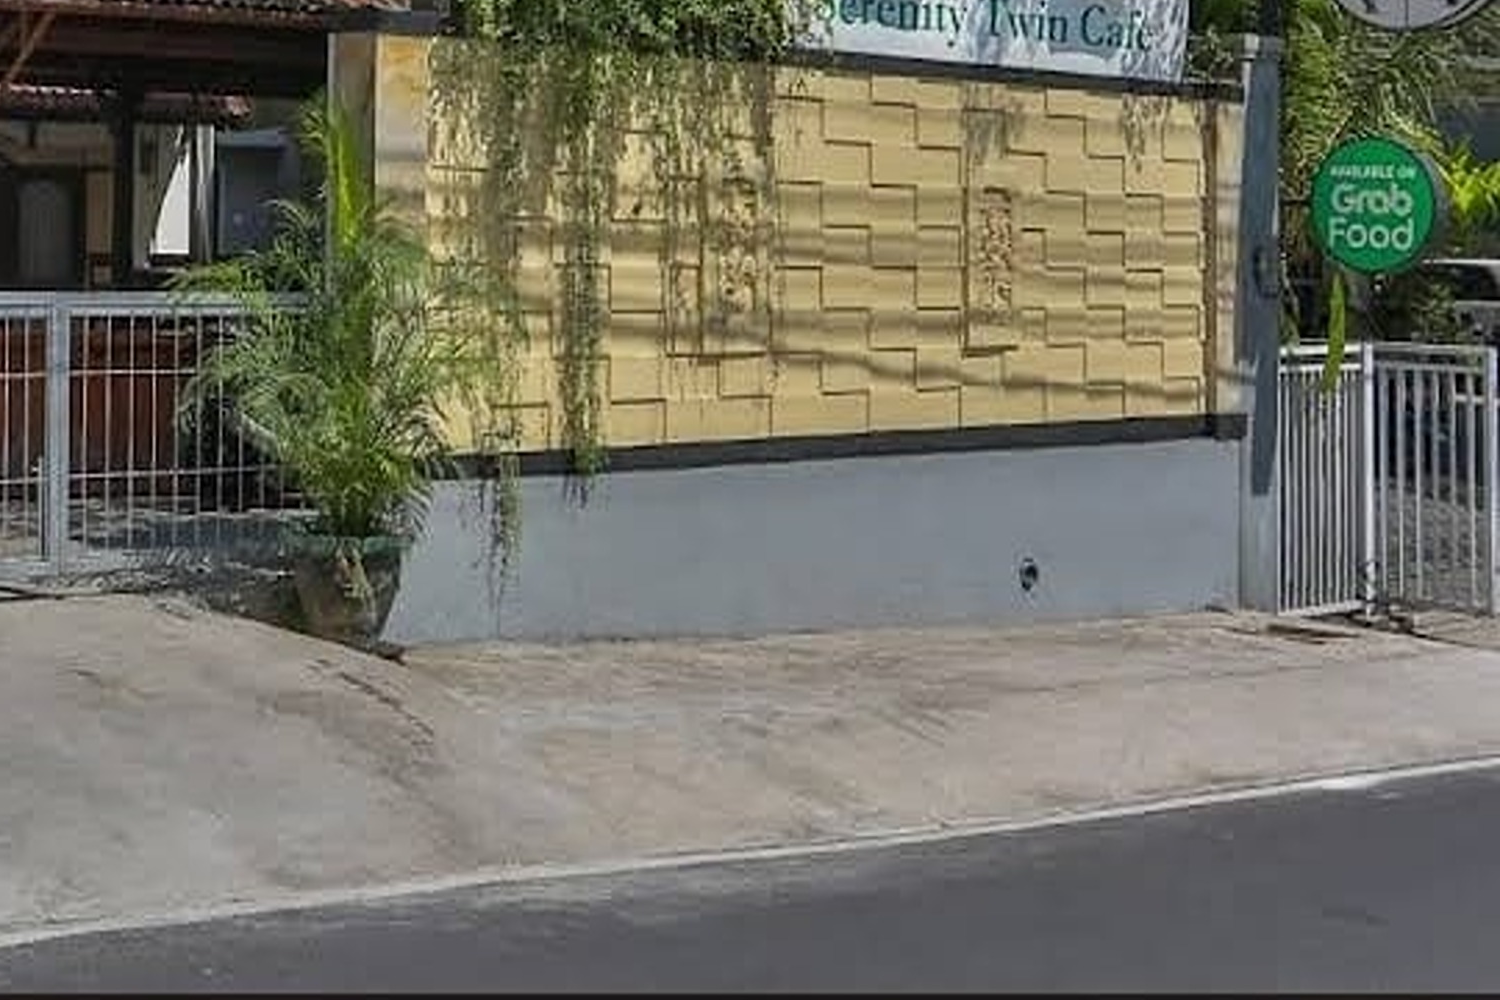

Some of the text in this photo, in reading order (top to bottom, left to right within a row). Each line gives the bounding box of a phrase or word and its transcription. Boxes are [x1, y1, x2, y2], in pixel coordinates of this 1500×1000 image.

[1329, 164, 1395, 179] AVAILABLE
[1330, 181, 1414, 217] Grab
[1328, 216, 1414, 251] Food
